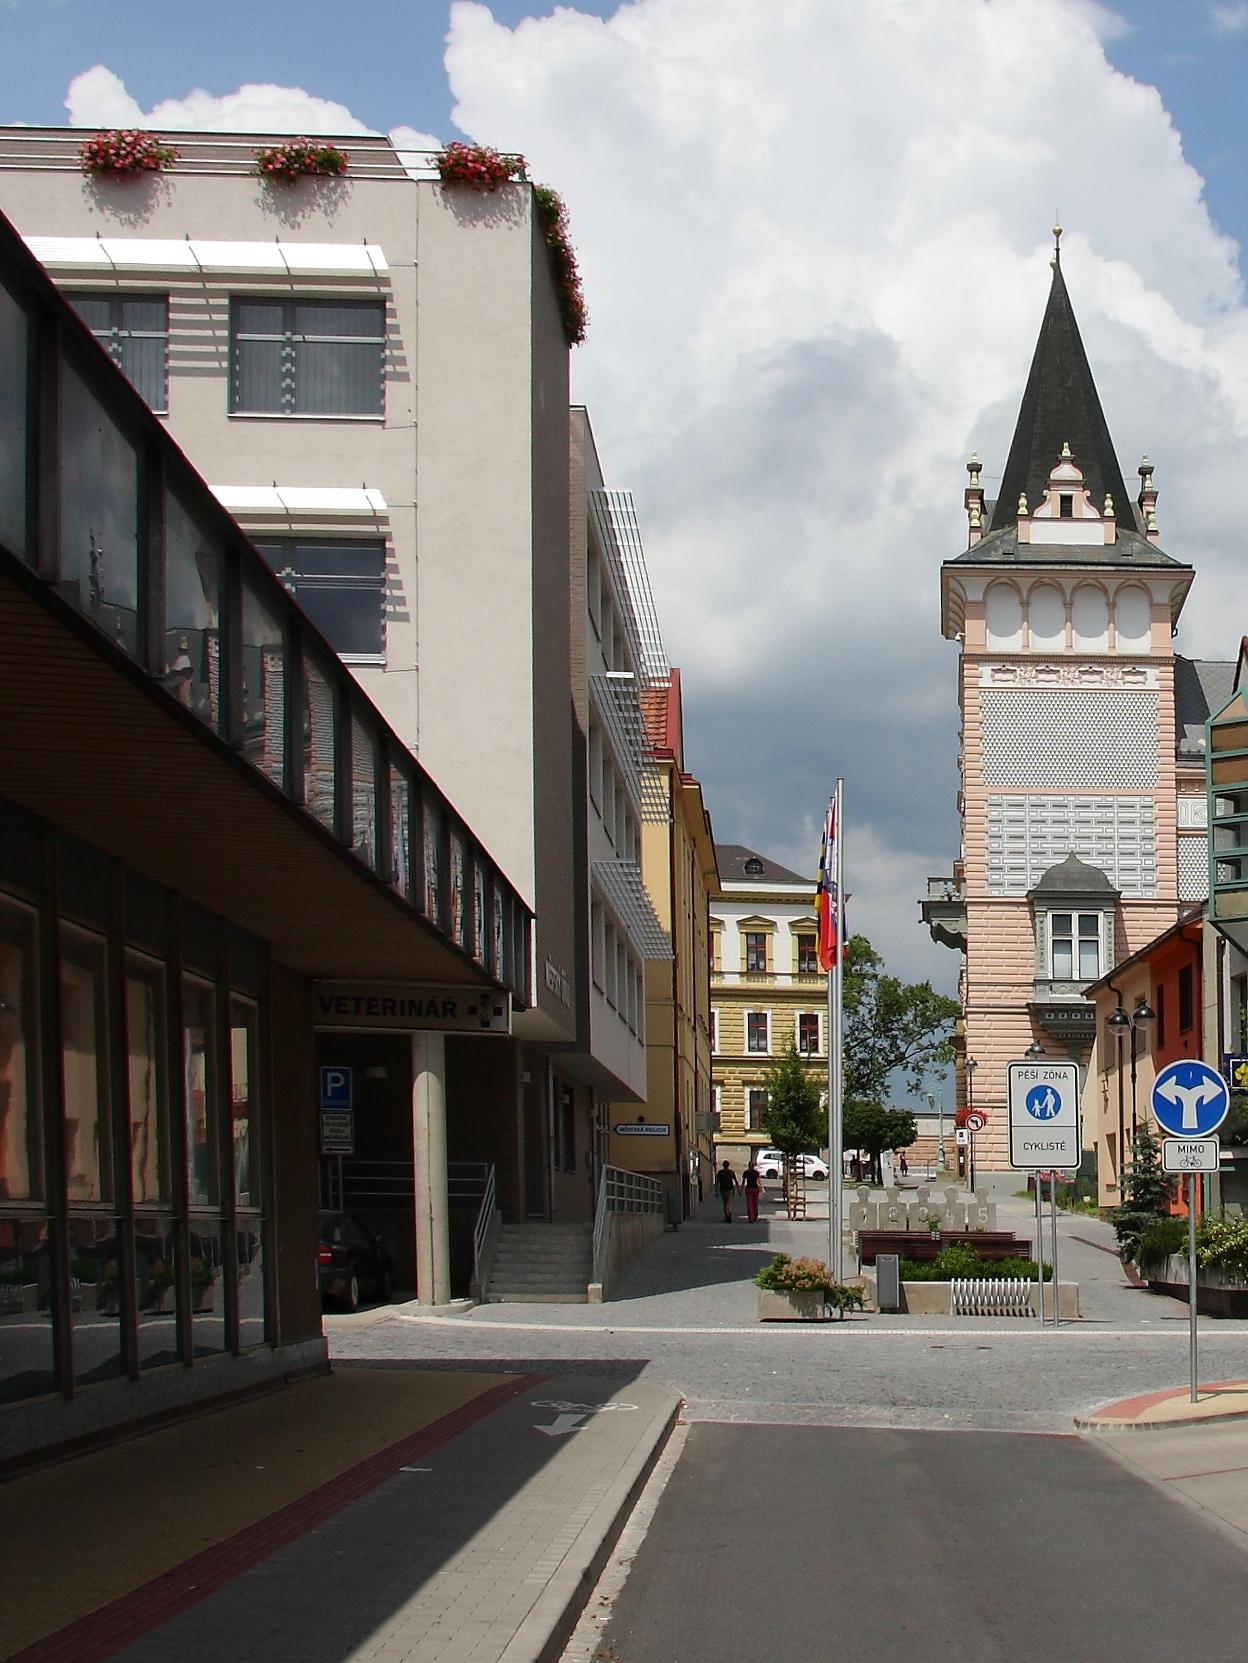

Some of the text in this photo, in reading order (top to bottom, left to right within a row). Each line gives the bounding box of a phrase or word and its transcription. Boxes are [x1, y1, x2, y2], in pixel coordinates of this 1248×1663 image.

[319, 995, 457, 1018] VETERINÁŘ
[1018, 1070, 1069, 1080] PĚŠÍ ZÓNA
[327, 1072, 345, 1097] P
[1023, 1140, 1066, 1150] CYKLISTÉ
[1177, 1145, 1205, 1154] MIMO
[860, 1207, 867, 1223] 1
[888, 1206, 899, 1223] 2
[978, 1207, 988, 1223] 5
